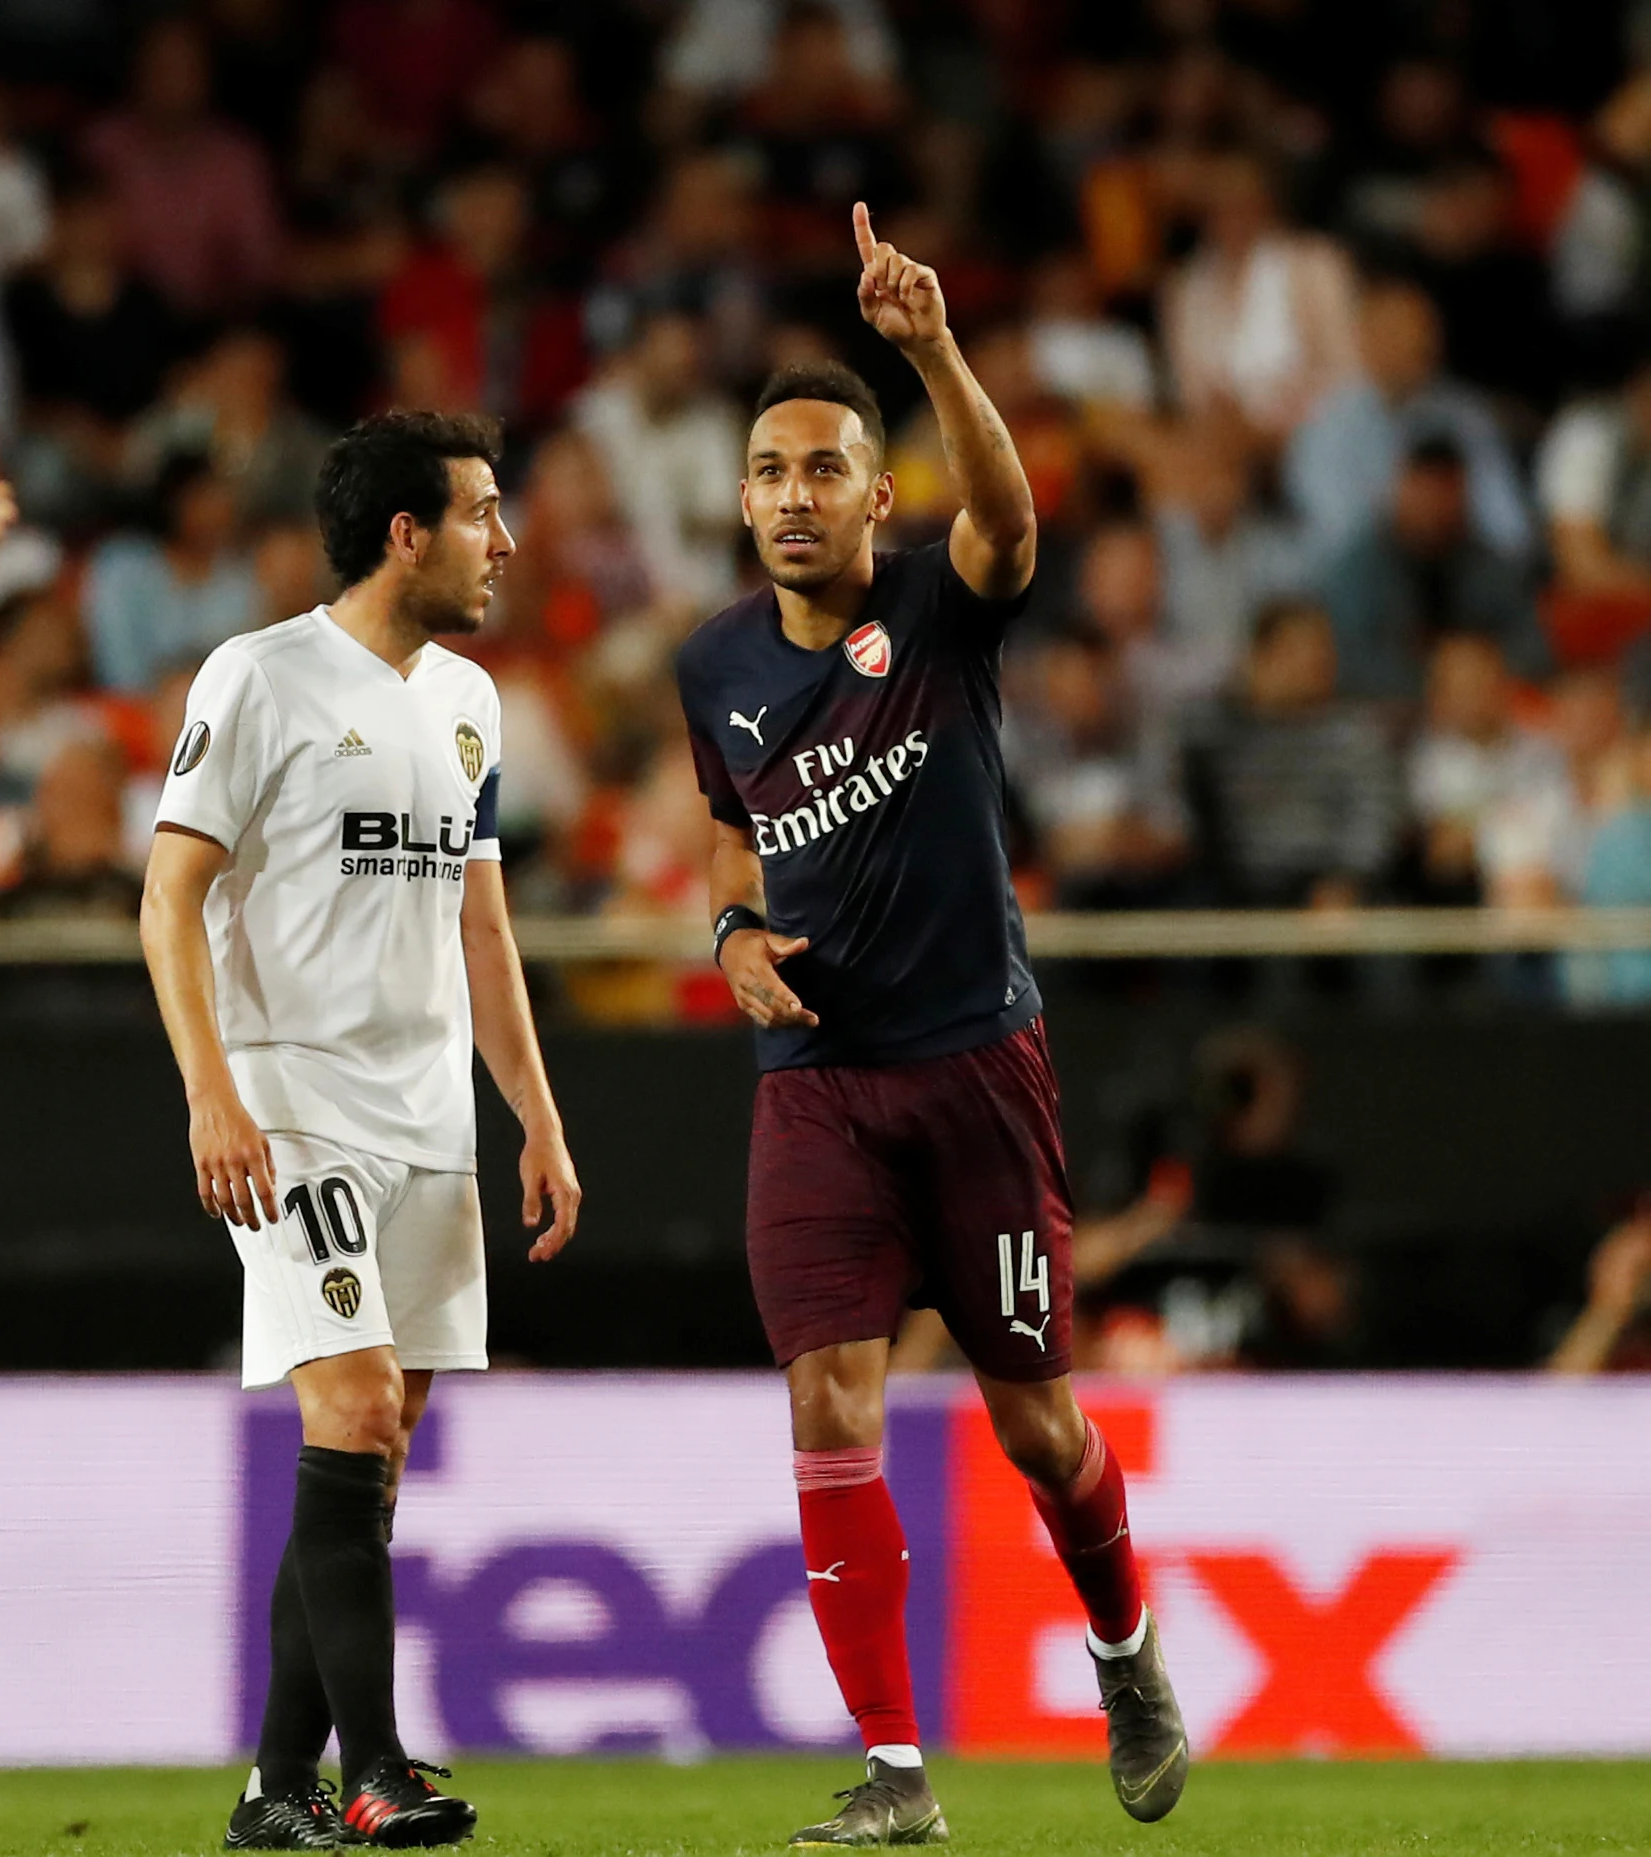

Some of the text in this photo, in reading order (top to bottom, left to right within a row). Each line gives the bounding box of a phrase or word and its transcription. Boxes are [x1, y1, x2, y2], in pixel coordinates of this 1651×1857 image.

[334, 746, 373, 757] adidas
[750, 730, 928, 856] Emirates
[341, 854, 463, 882] smartphne
[281, 1175, 368, 1265] 10
[998, 1230, 1049, 1316] 14
